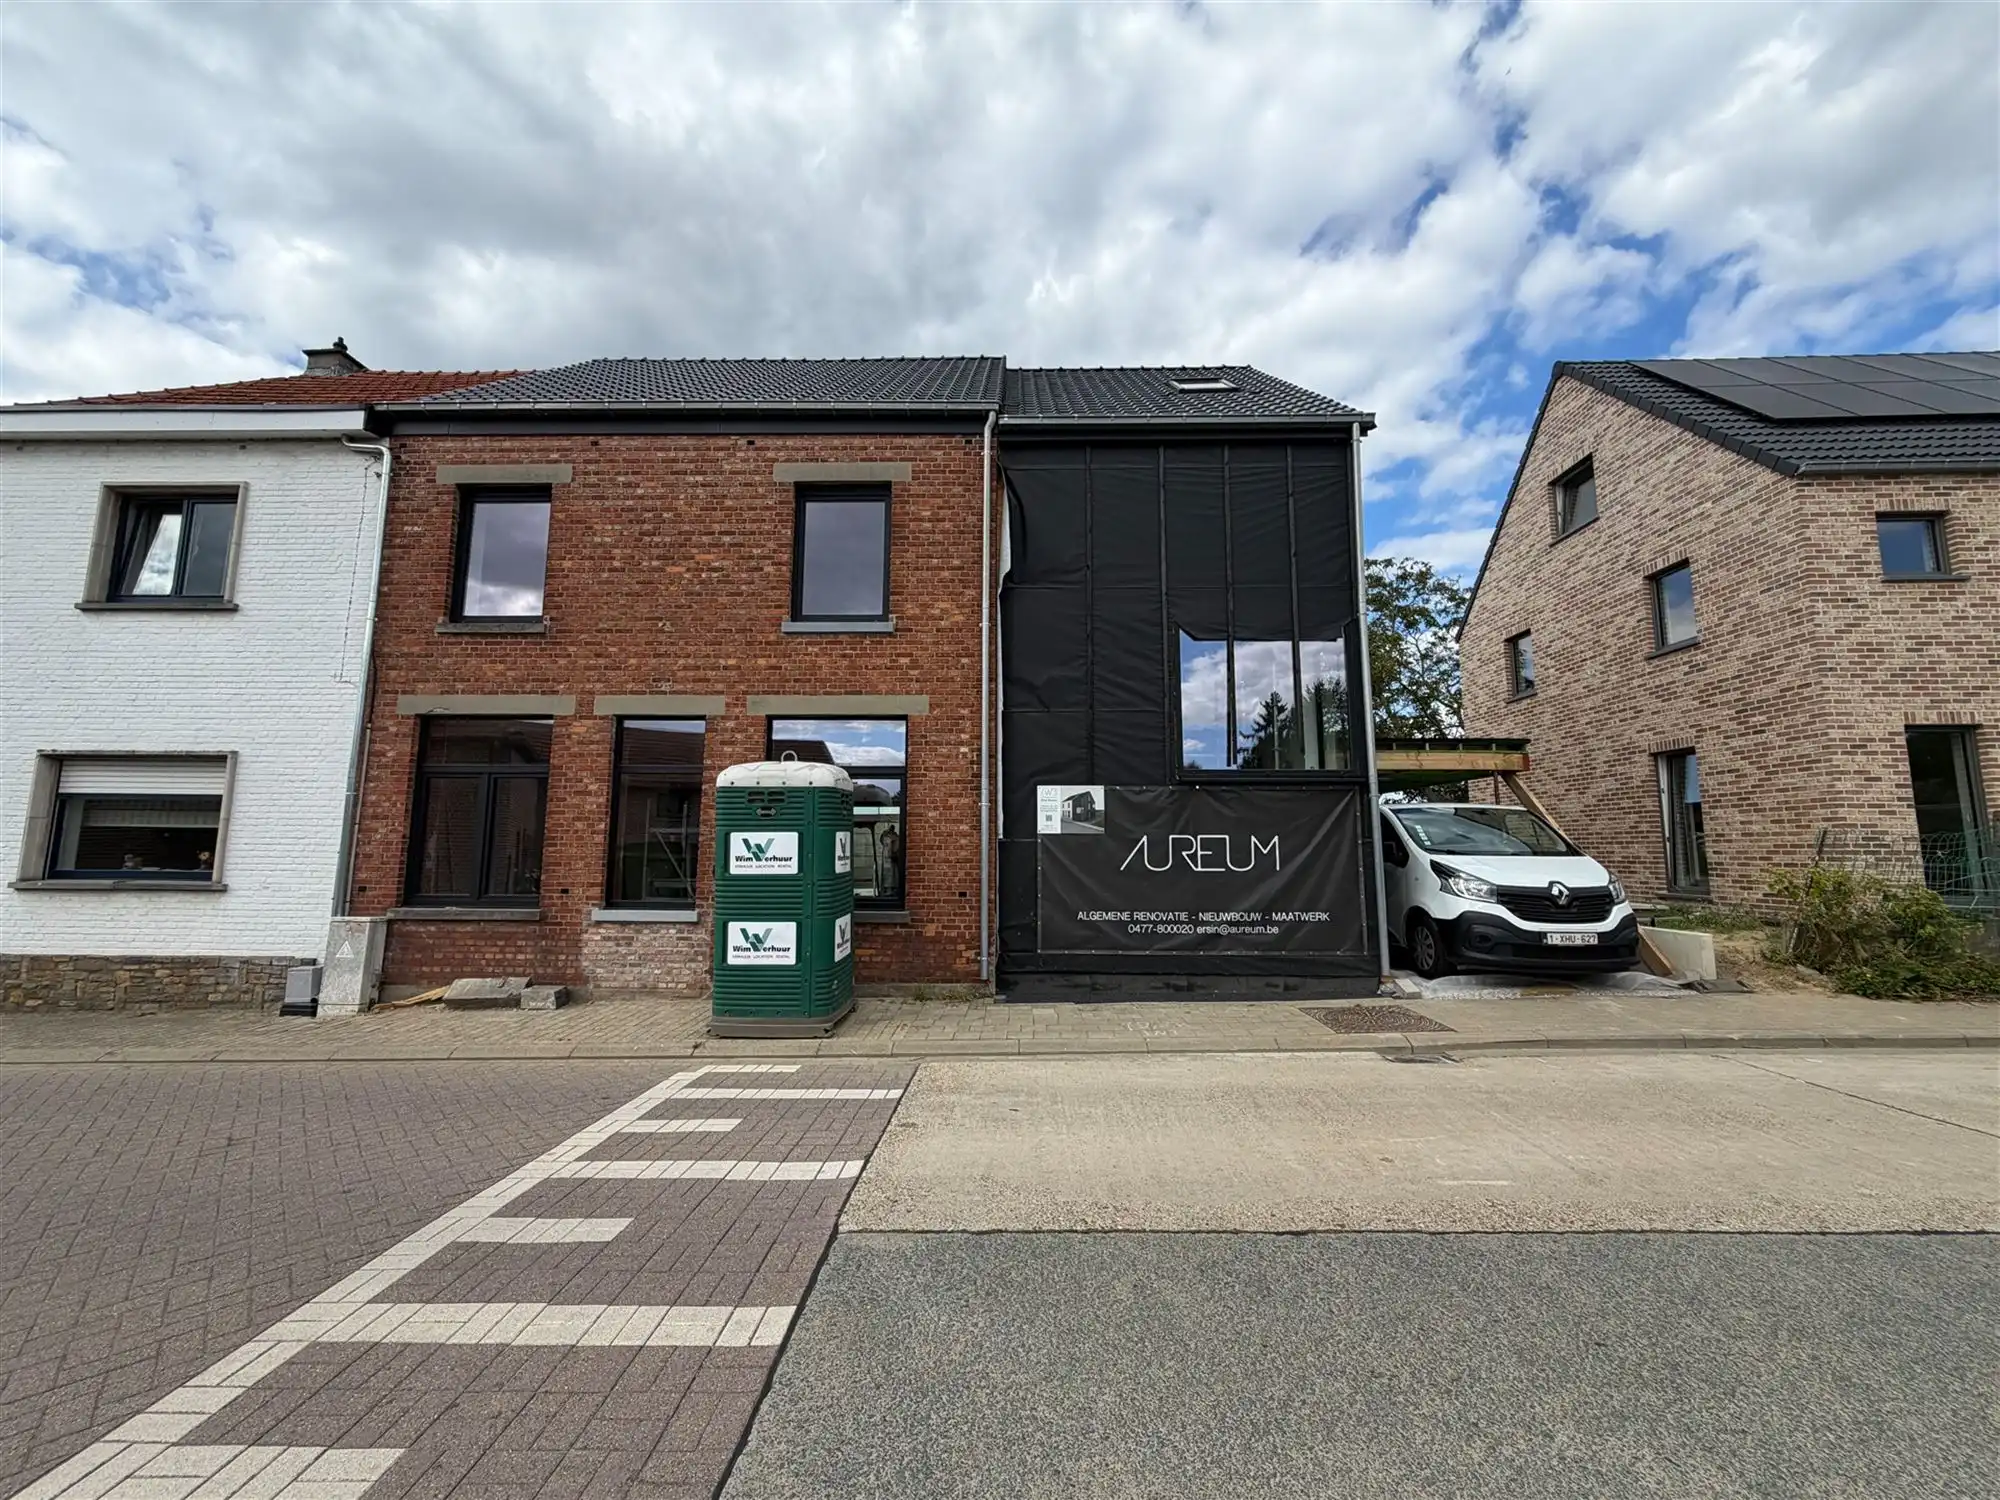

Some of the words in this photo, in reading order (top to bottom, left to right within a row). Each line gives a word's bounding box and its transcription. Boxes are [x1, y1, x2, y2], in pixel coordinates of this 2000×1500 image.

[1120, 834, 1280, 872] AUREUM
[1077, 911, 1131, 921] ALGEMENE
[1133, 911, 1189, 921] RENOVATIE
[1198, 911, 1262, 921] NIEUWBOUW
[1272, 911, 1330, 921] MAATWERK
[1127, 923, 1195, 934] 0477-800020
[1196, 923, 1279, 935] ersin@aureum.be
